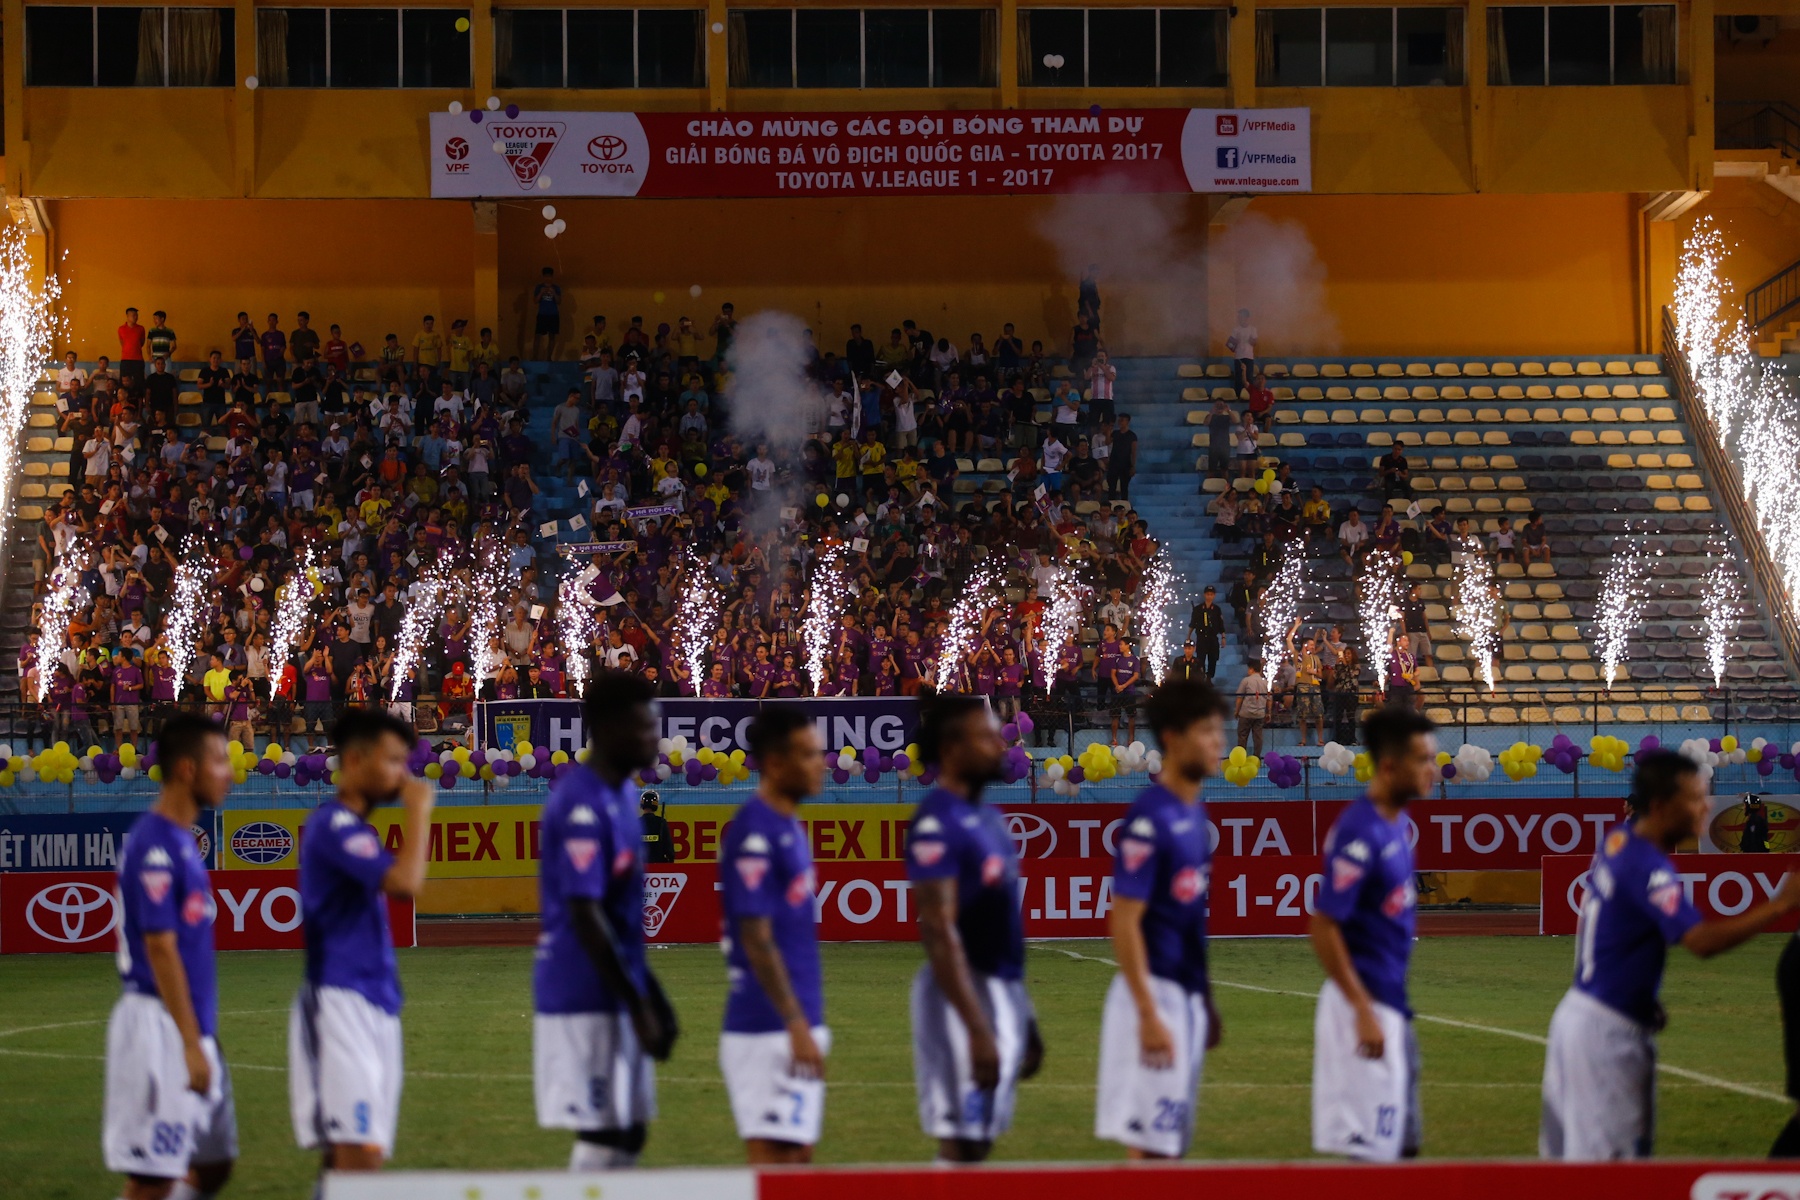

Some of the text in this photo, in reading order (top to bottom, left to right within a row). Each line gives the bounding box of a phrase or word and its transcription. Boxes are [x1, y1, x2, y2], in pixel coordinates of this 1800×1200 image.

[493, 127, 557, 138] TOYOTA
[686, 115, 1144, 139] CHÀO MỪNG CÁC ĐỘI BÓNG THAM DỰ
[1242, 118, 1296, 132] /VPFMedia
[665, 142, 707, 164] GIẢI
[714, 144, 771, 164] BÓNG
[777, 144, 806, 164] ĐÁ
[812, 143, 840, 164] VÔ
[846, 146, 898, 167] ĐỊCH
[905, 139, 963, 165] QUỐC
[969, 144, 1005, 162] GIA
[1026, 143, 1106, 161] TOYOTA
[1112, 143, 1164, 160] 2017
[1241, 150, 1296, 165] /VPFMedia
[445, 163, 470, 172] VPF
[580, 163, 634, 174] TOYOTA
[775, 171, 855, 189] TOYOTA
[861, 170, 960, 189] V.LEAGUE
[967, 169, 977, 187] 1
[1002, 168, 1054, 187] 2017
[1214, 176, 1299, 187] www.vnleague.com
[550, 714, 905, 752] HECING
[232, 838, 291, 848] BECAMEX
[667, 820, 866, 860] BEEX
[1430, 812, 1616, 854] TOYOT
[30, 833, 78, 867] KIM
[84, 827, 117, 866] HÀ
[643, 877, 680, 888] YOTA
[1228, 873, 1326, 917] 1-20
[1675, 871, 1791, 916] TOY
